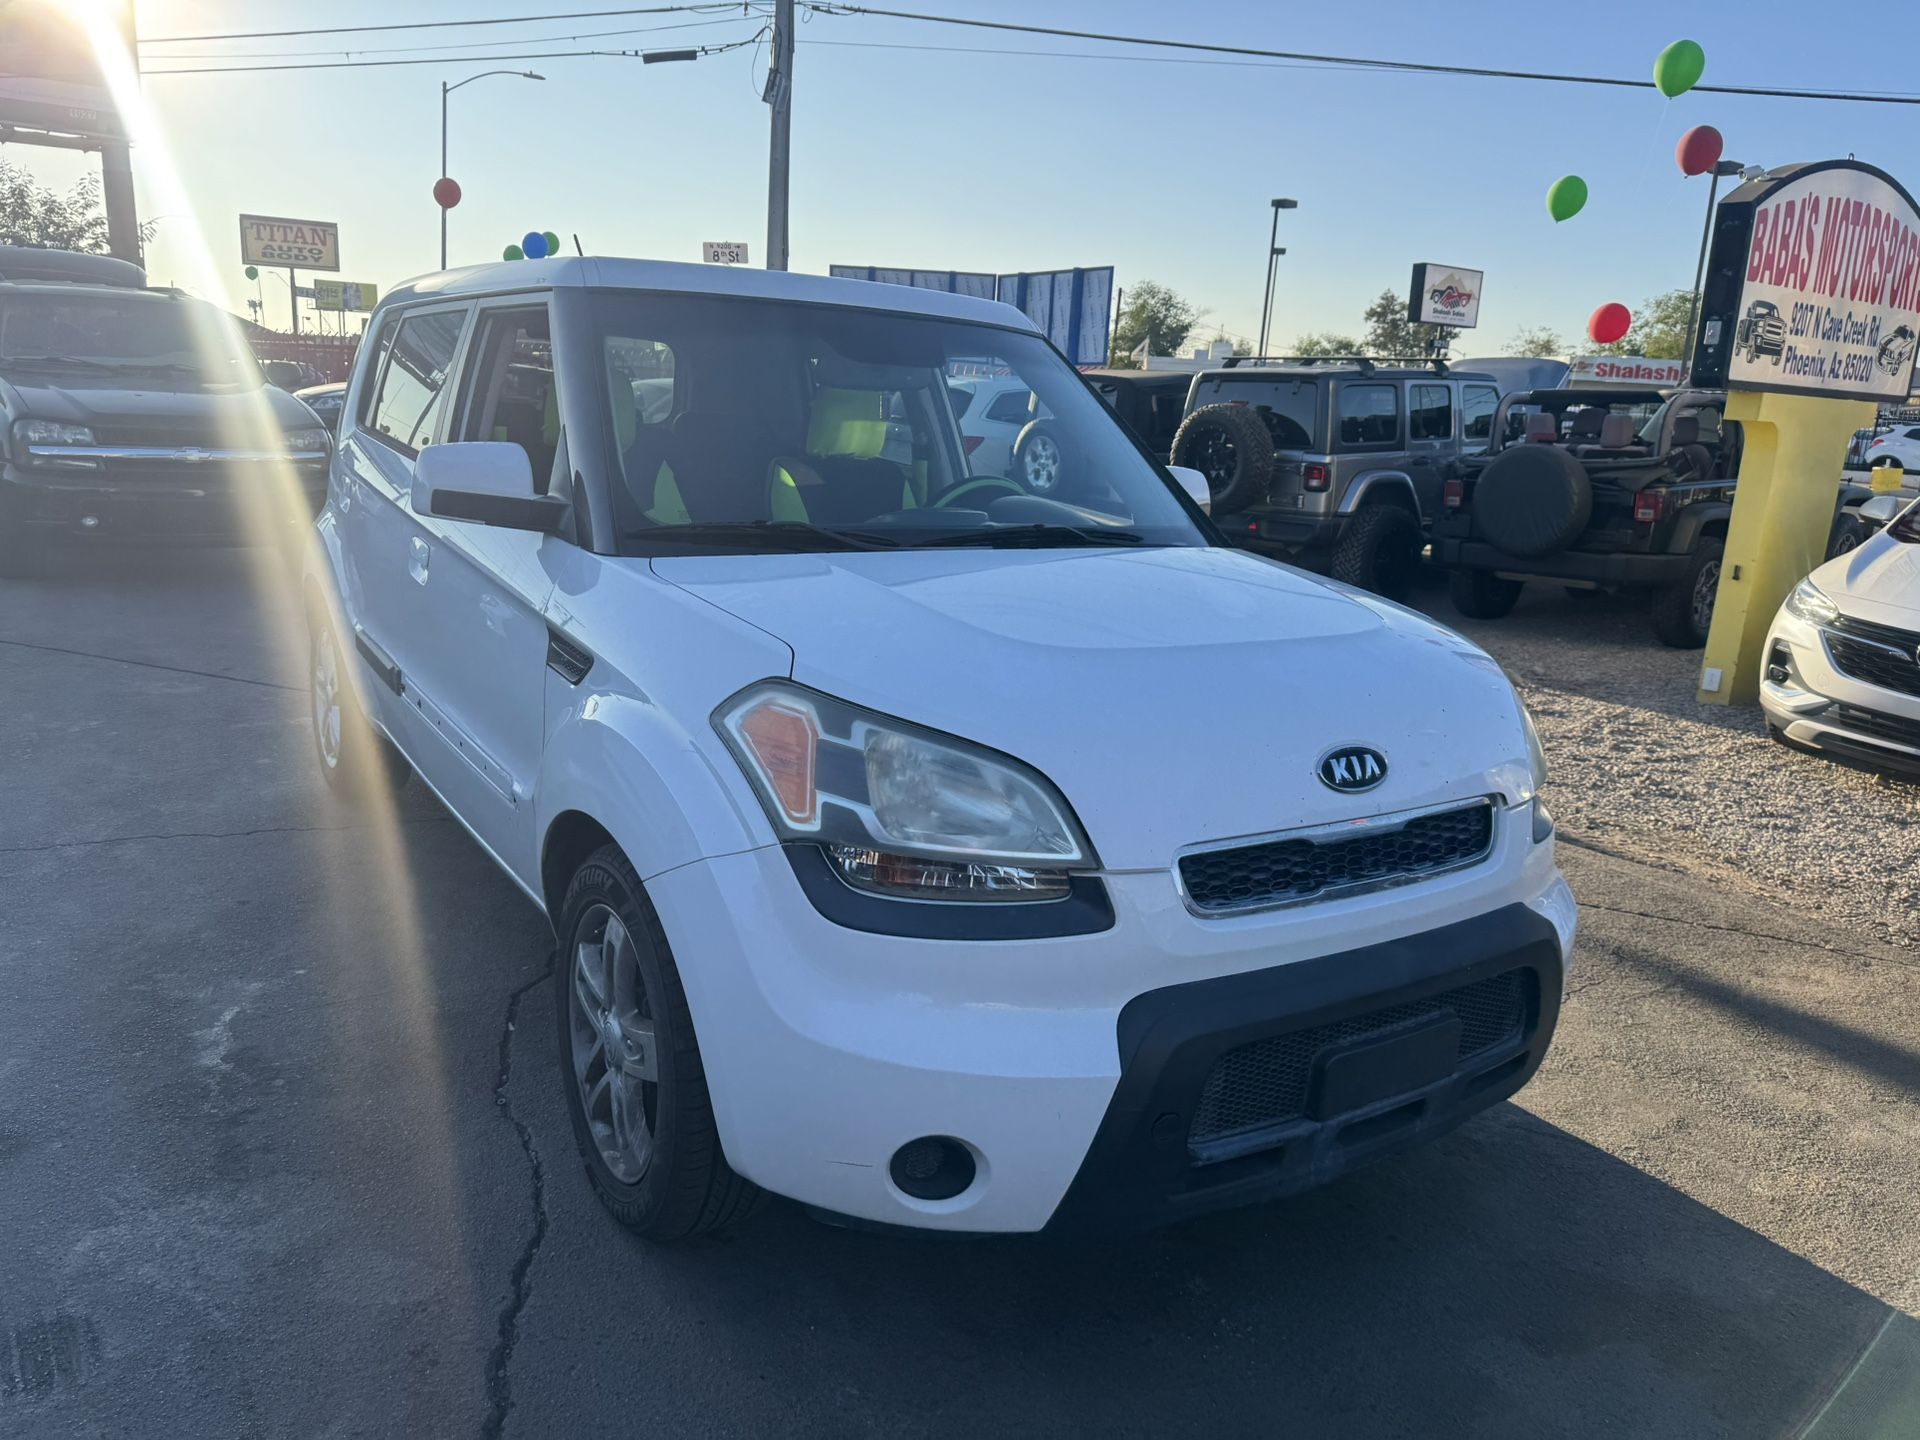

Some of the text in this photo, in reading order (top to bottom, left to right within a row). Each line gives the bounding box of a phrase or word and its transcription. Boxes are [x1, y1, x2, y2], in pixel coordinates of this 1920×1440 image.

[250, 222, 328, 247] TITAN
[1747, 192, 1820, 292] BABA'S
[261, 251, 323, 263] BODY
[262, 244, 323, 256] AUTO
[728, 250, 739, 263] St
[1790, 301, 1815, 338] 9207
[1812, 305, 1823, 339] N
[1822, 307, 1843, 342] Cave
[1843, 311, 1868, 345] Creek
[1595, 362, 1680, 381] Shalash
[1783, 345, 1873, 384] Phoenix, Az 85020
[1329, 753, 1380, 784] KIA
